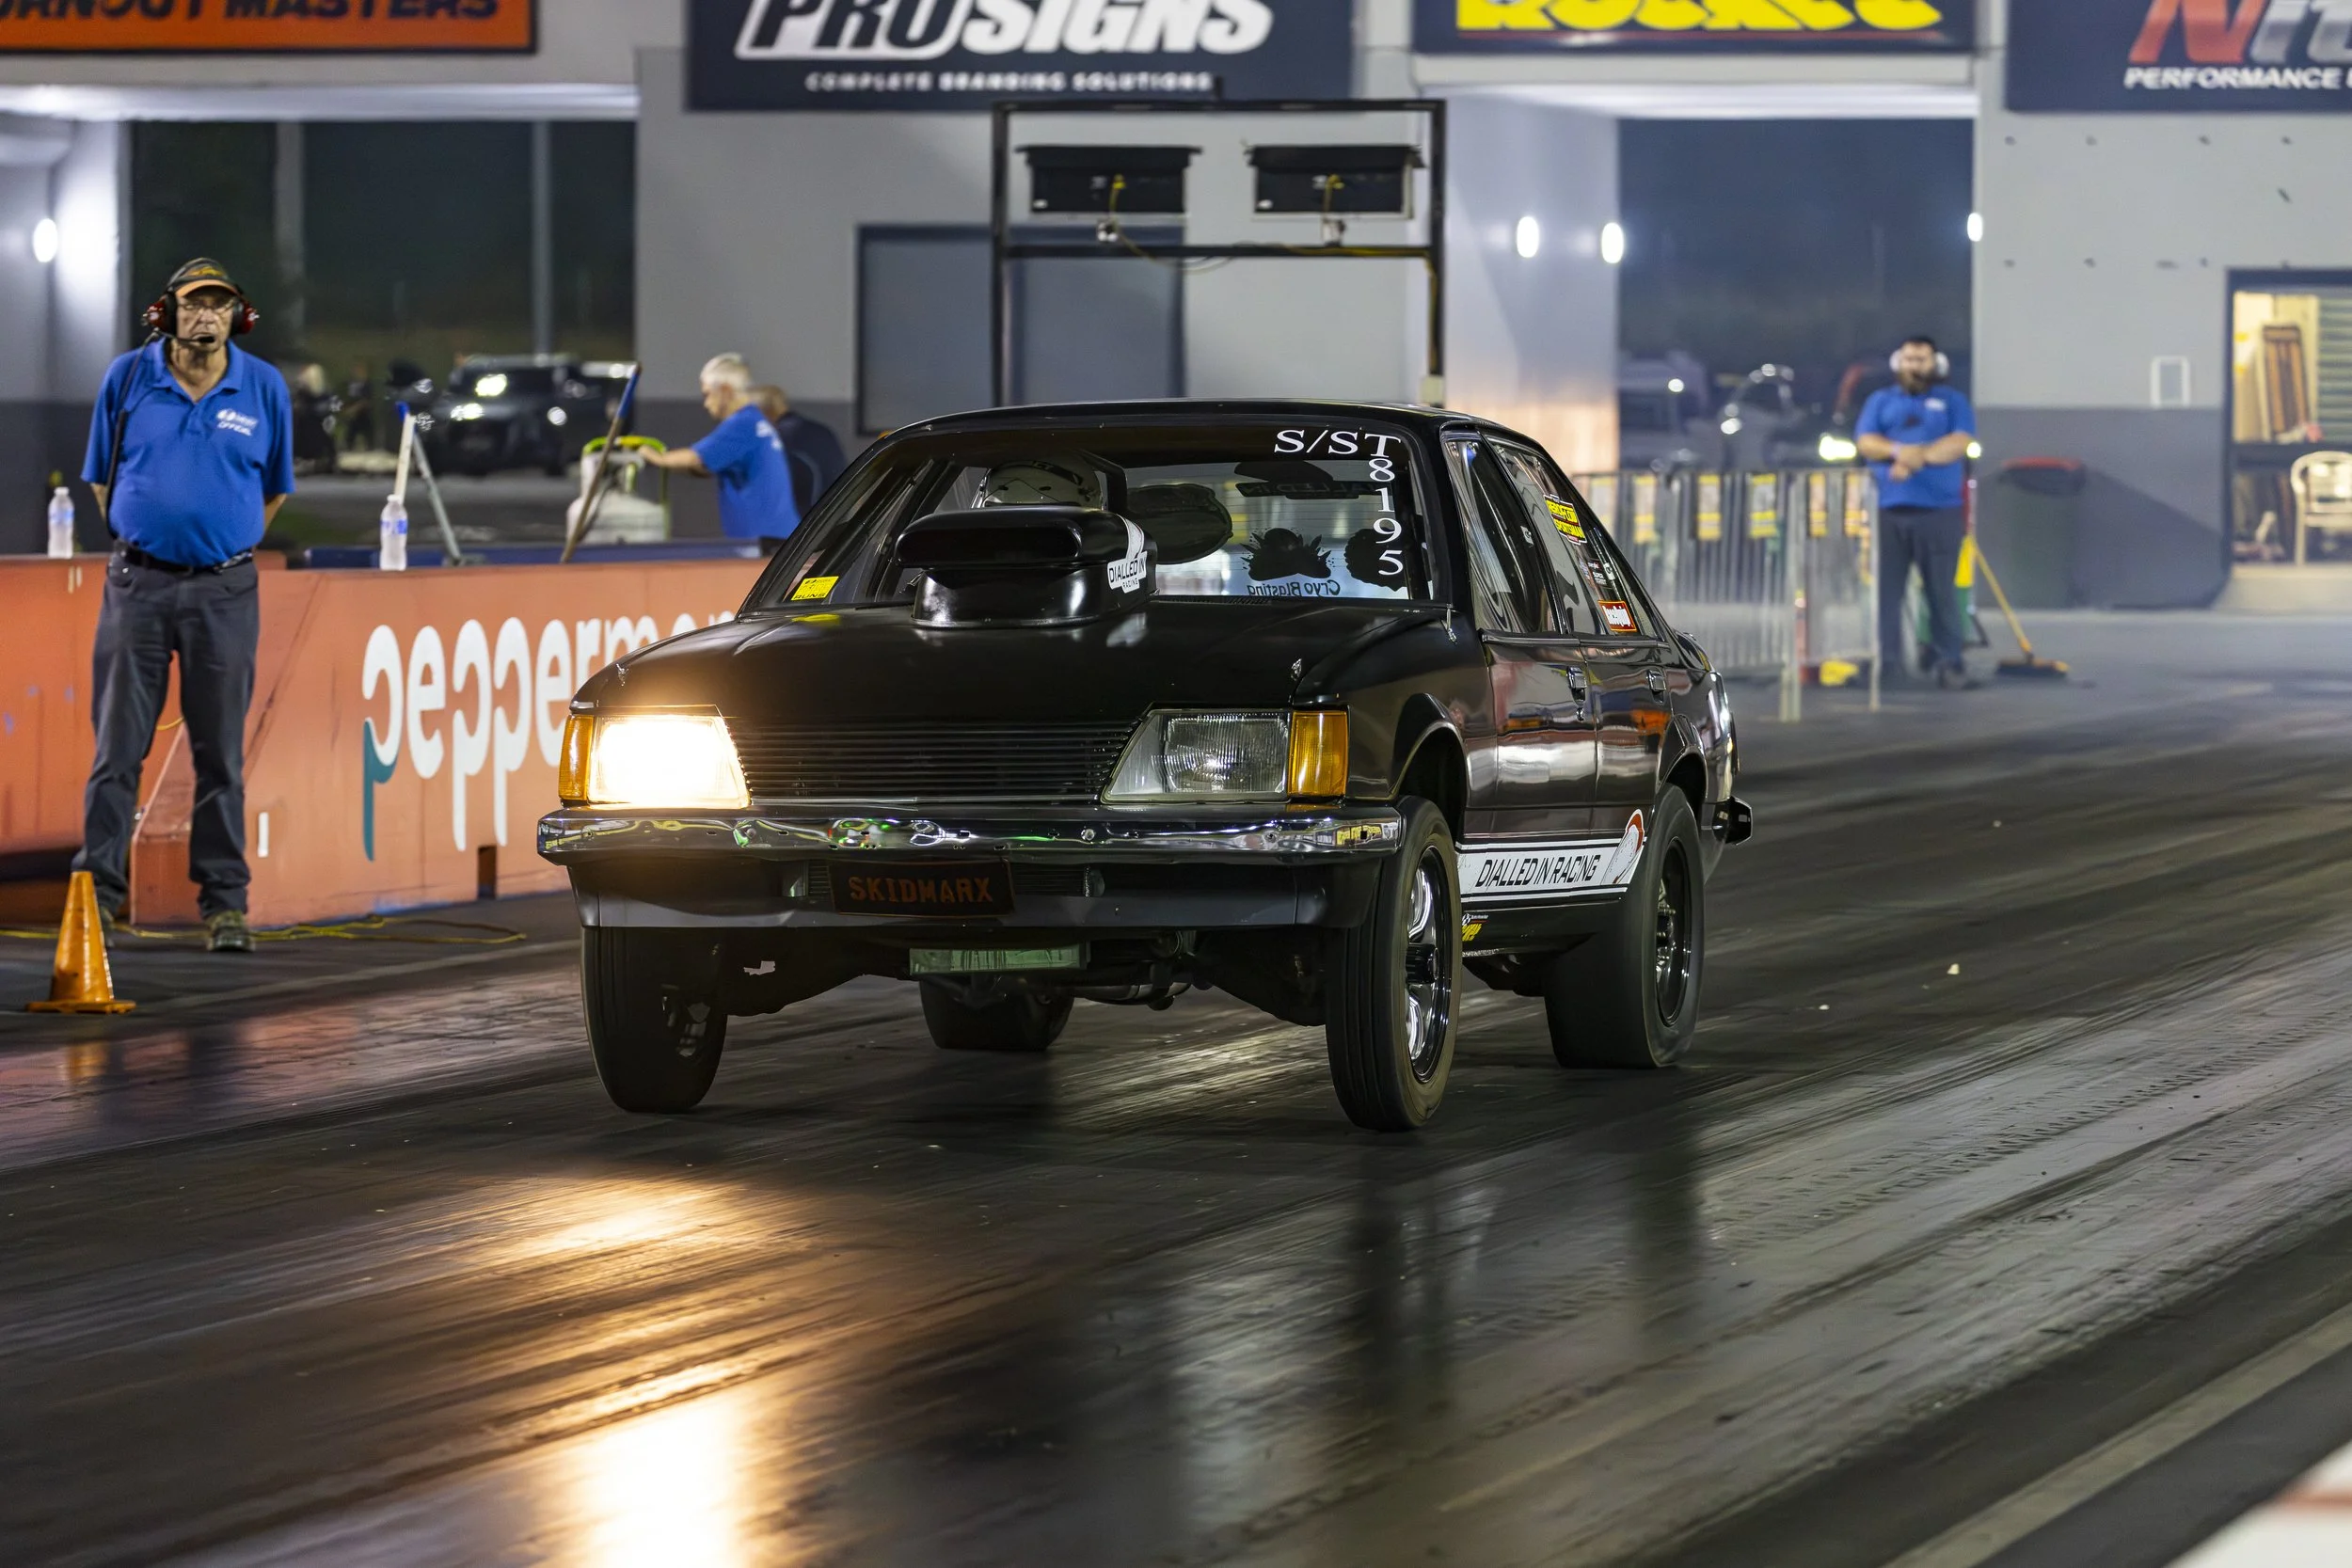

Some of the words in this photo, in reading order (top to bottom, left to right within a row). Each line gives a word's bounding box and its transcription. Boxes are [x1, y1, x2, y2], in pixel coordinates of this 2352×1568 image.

[0, 0, 204, 19] RNOUT
[739, 0, 1274, 57] PROSIGNS
[805, 71, 932, 92] COMPLETE
[939, 71, 1067, 92] BRANDING
[1073, 71, 1213, 92] SOLUTIONS
[2123, 67, 2342, 90] PERFORMANCE
[1274, 429, 1402, 459] S/ST
[1368, 458, 1404, 576] 8195
[1108, 560, 1138, 583] DIALLED
[361, 610, 735, 863] pepper
[1475, 859, 1538, 887] DIALLED
[1534, 857, 1554, 885] IN
[1551, 855, 1601, 884] RACING
[848, 876, 993, 904] SKIDMARX
